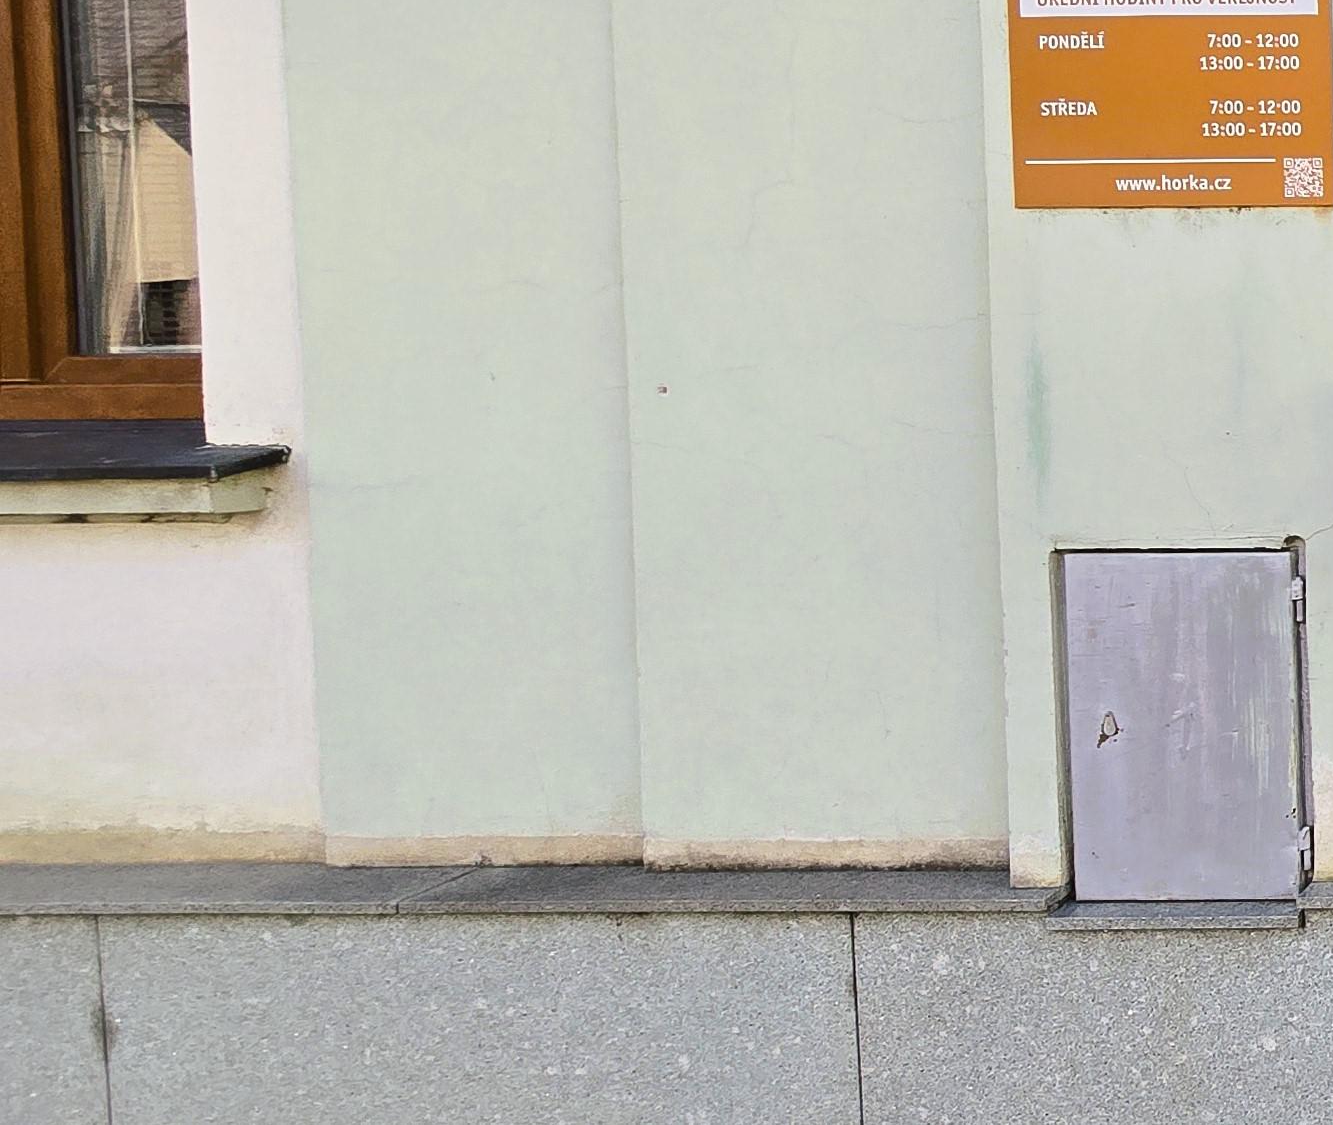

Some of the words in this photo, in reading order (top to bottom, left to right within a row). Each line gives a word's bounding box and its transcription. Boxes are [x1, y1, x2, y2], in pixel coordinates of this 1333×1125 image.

[1039, 31, 1105, 49] PONDĚLÍ
[1207, 33, 1241, 48] 7:00
[1255, 33, 1299, 48] 12:00
[1200, 56, 1243, 70] 13:00
[1257, 56, 1300, 70] 17:00
[1040, 99, 1098, 116] STŘEDA
[1209, 100, 1244, 115] 7:00
[1258, 100, 1301, 114] 12:00
[1202, 122, 1246, 137] 13:00
[1259, 122, 1302, 136] 17:00
[1115, 174, 1232, 191] www.horka.cz
